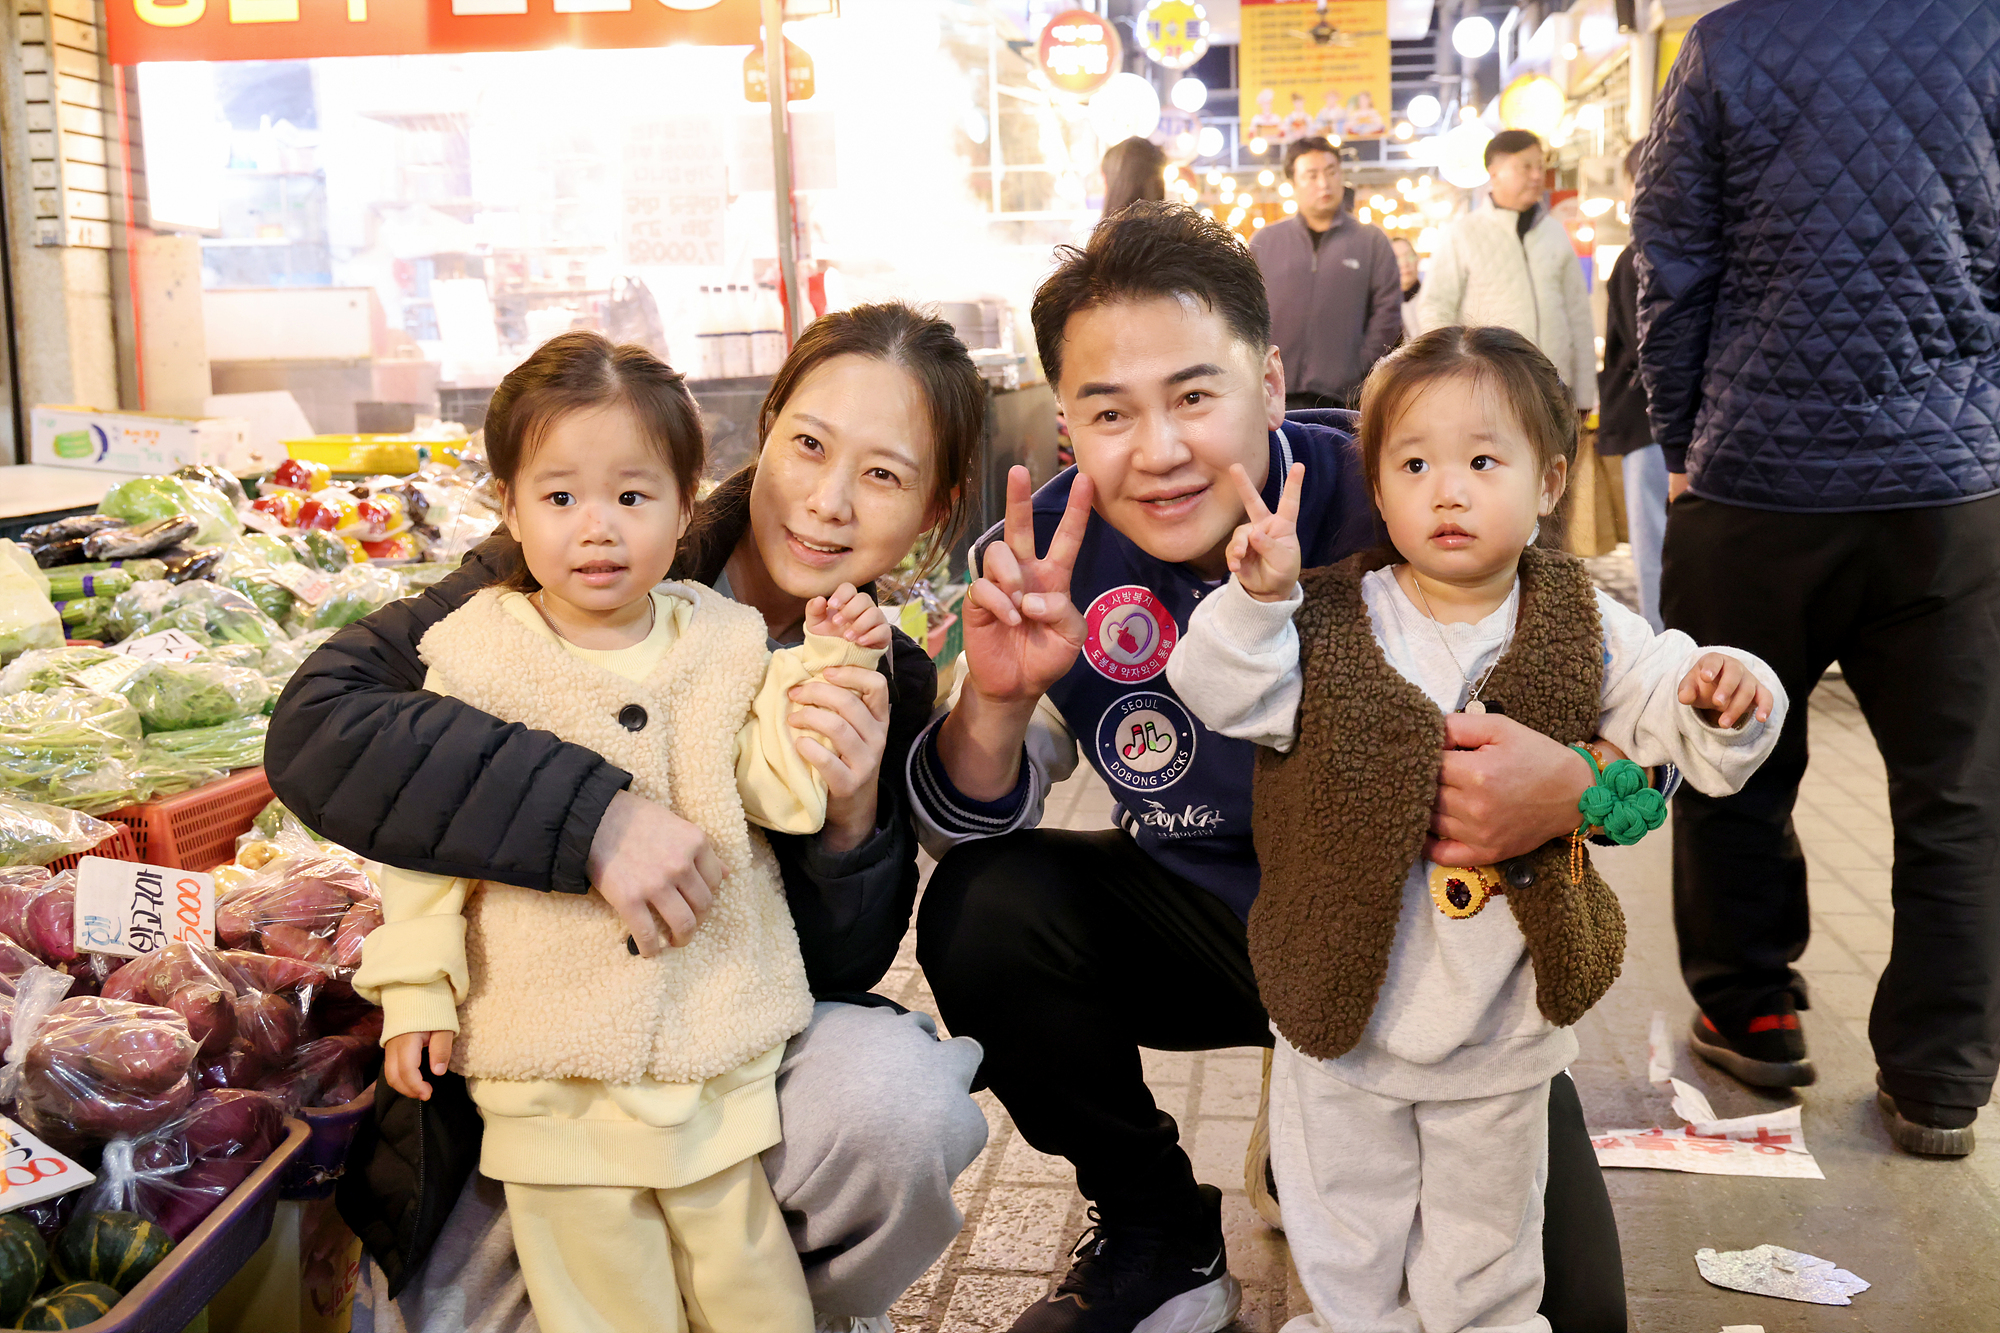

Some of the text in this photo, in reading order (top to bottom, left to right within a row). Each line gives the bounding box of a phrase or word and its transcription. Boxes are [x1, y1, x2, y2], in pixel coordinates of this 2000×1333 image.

[1120, 698, 1158, 715] SEOUL
[1110, 750, 1189, 787] DOBONG SOCKS
